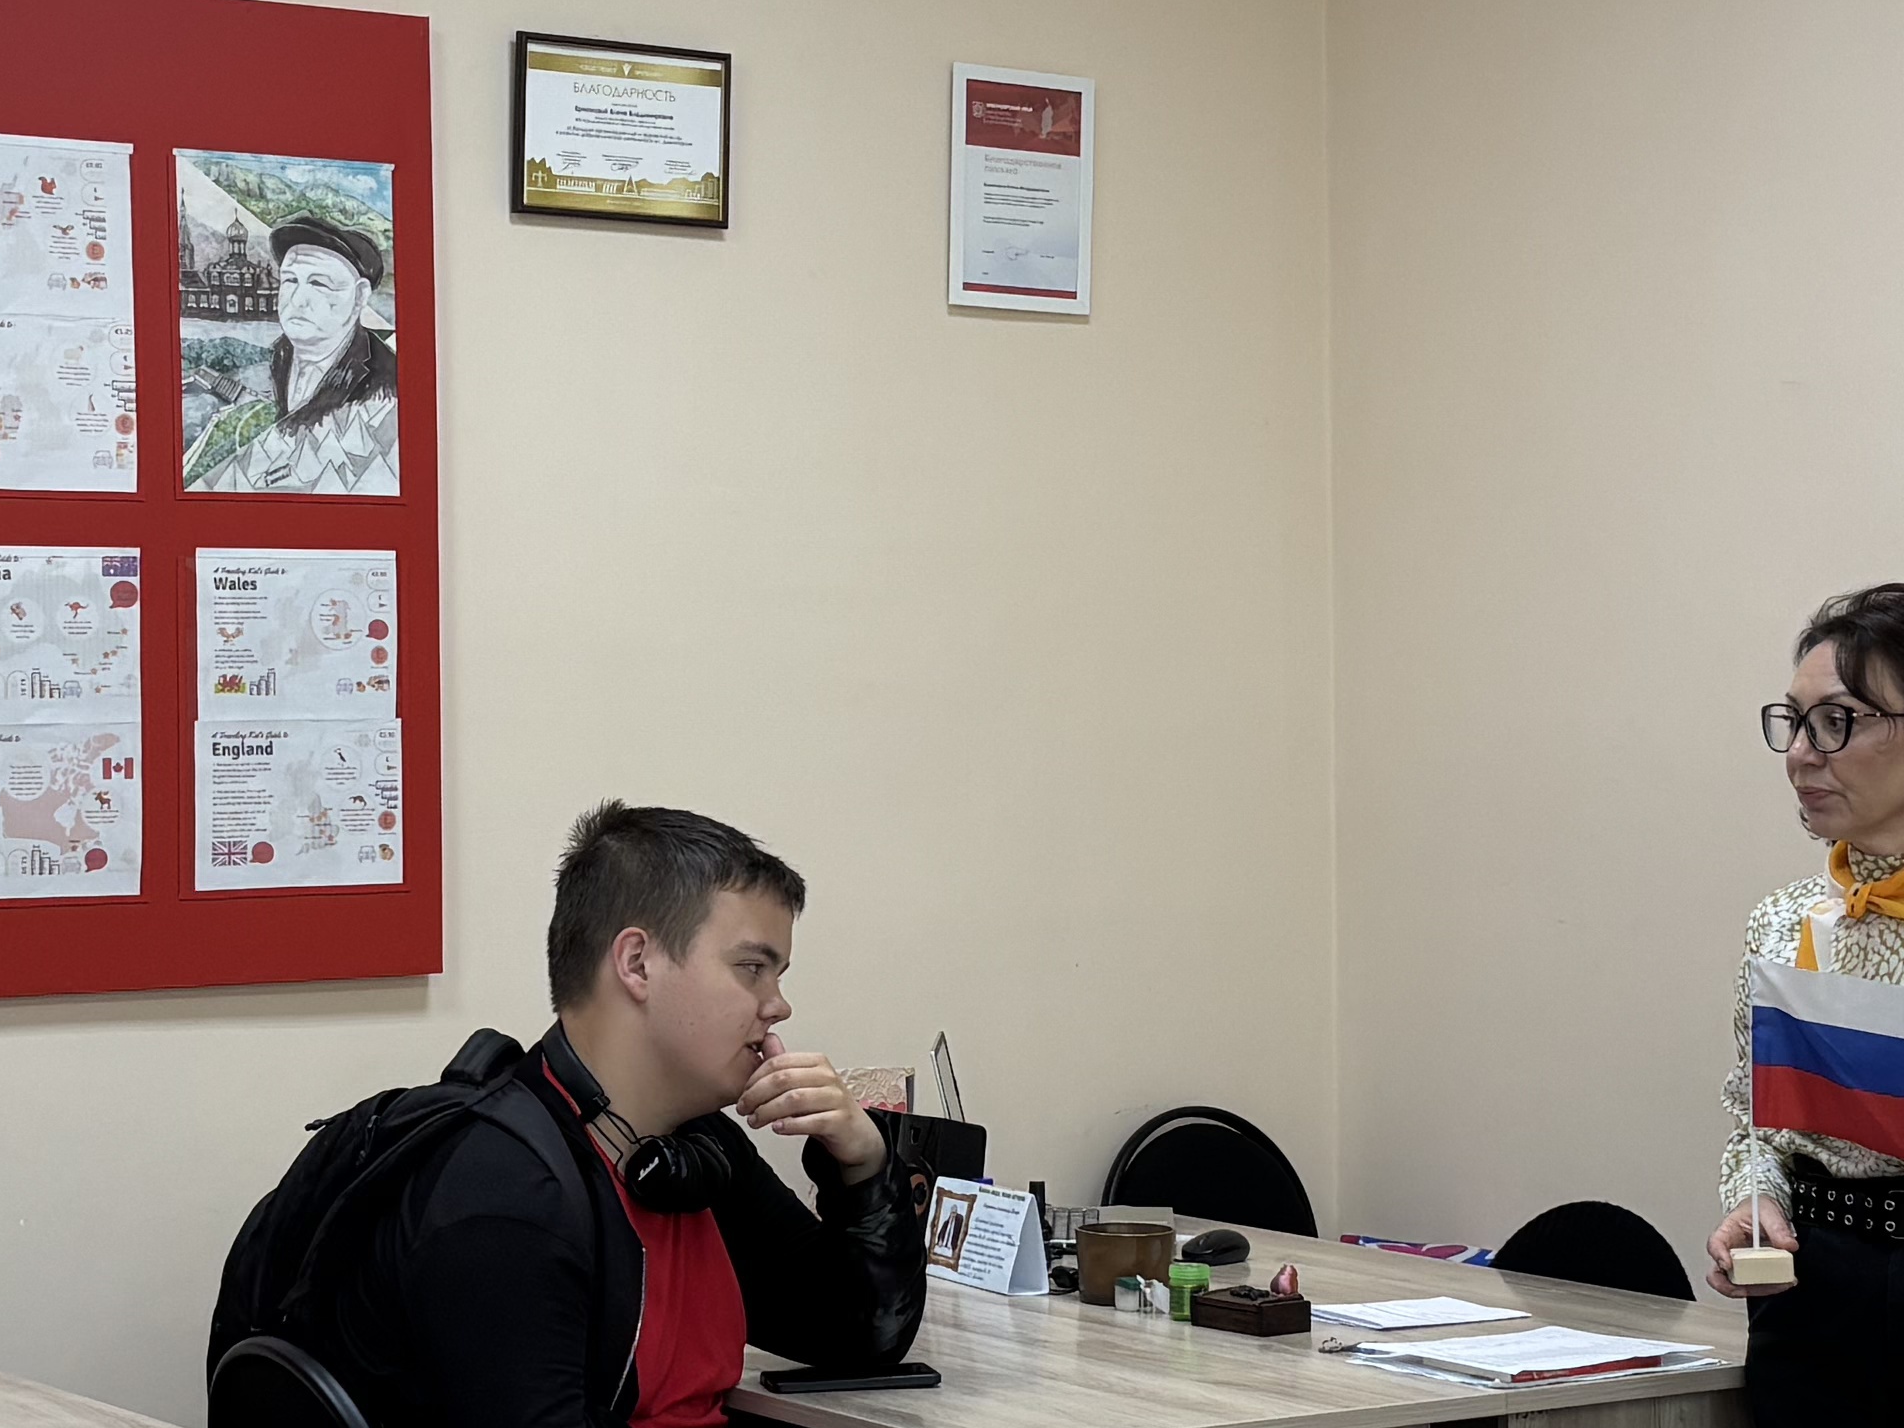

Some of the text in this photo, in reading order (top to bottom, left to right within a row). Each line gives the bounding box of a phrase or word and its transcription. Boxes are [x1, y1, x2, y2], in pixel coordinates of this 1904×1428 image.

[573, 82, 676, 103] БЛАГОДАРНОСТЬ
[213, 576, 258, 591] Wales
[212, 740, 274, 760] England
